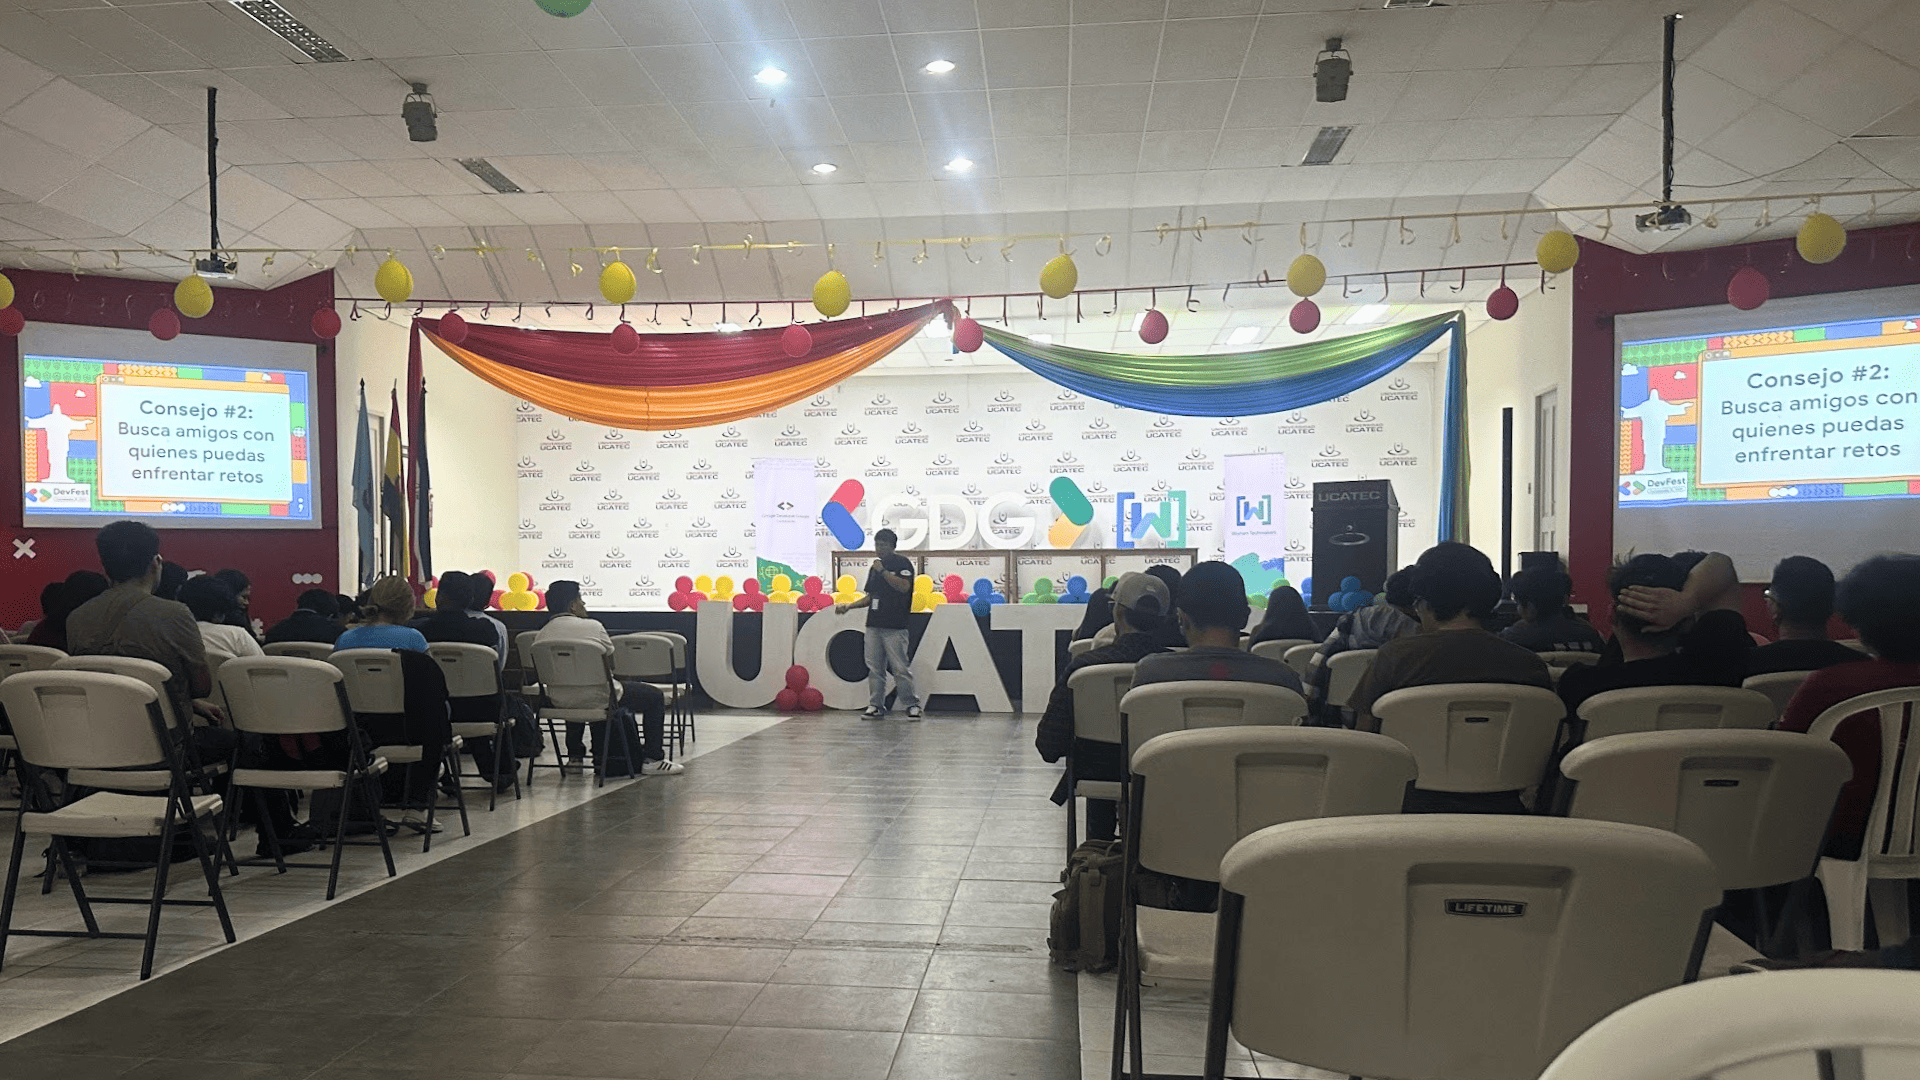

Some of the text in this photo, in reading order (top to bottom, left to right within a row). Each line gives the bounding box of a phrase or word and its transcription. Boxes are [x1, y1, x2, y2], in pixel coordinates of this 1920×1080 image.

[1747, 364, 1889, 388] Consejo #2:
[140, 400, 253, 420] Consejo #2:
[1722, 391, 1917, 415] Busca amigos con
[118, 422, 274, 442] Busca amigos con
[1732, 416, 1904, 442] quienes puedas
[129, 445, 265, 462] quienes puedas
[1735, 443, 1901, 463] enfrentar retos
[132, 467, 263, 483] enfrentar retos
[1648, 478, 1685, 486] DevFest
[1318, 491, 1380, 501] UCATEC
[872, 493, 1036, 550] GDG
[1456, 902, 1516, 913] LIFETIME
